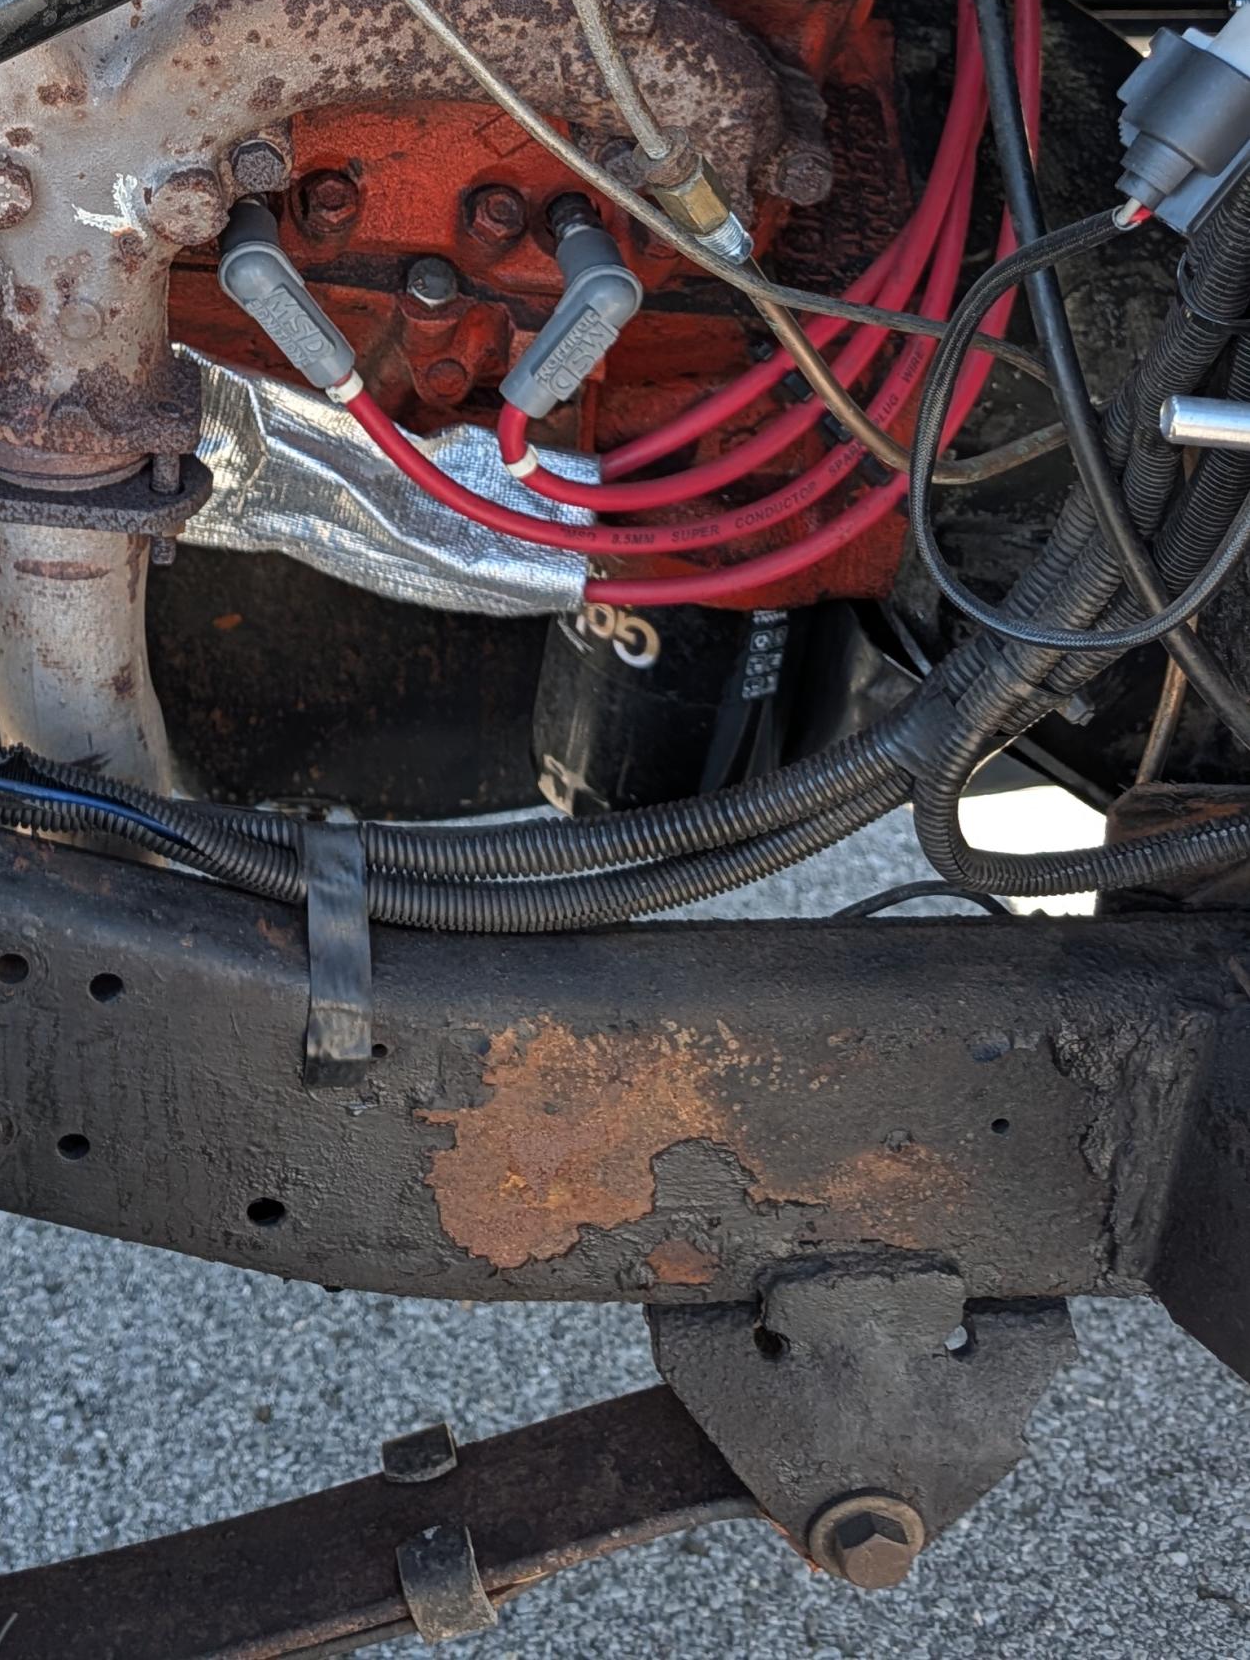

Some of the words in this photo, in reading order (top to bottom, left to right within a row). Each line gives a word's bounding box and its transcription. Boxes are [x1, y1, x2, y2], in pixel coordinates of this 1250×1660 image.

[262, 287, 334, 361] MSD
[548, 320, 617, 400] MSD
[671, 524, 720, 542] SUPER
[734, 480, 818, 530] CONDUCTOR
